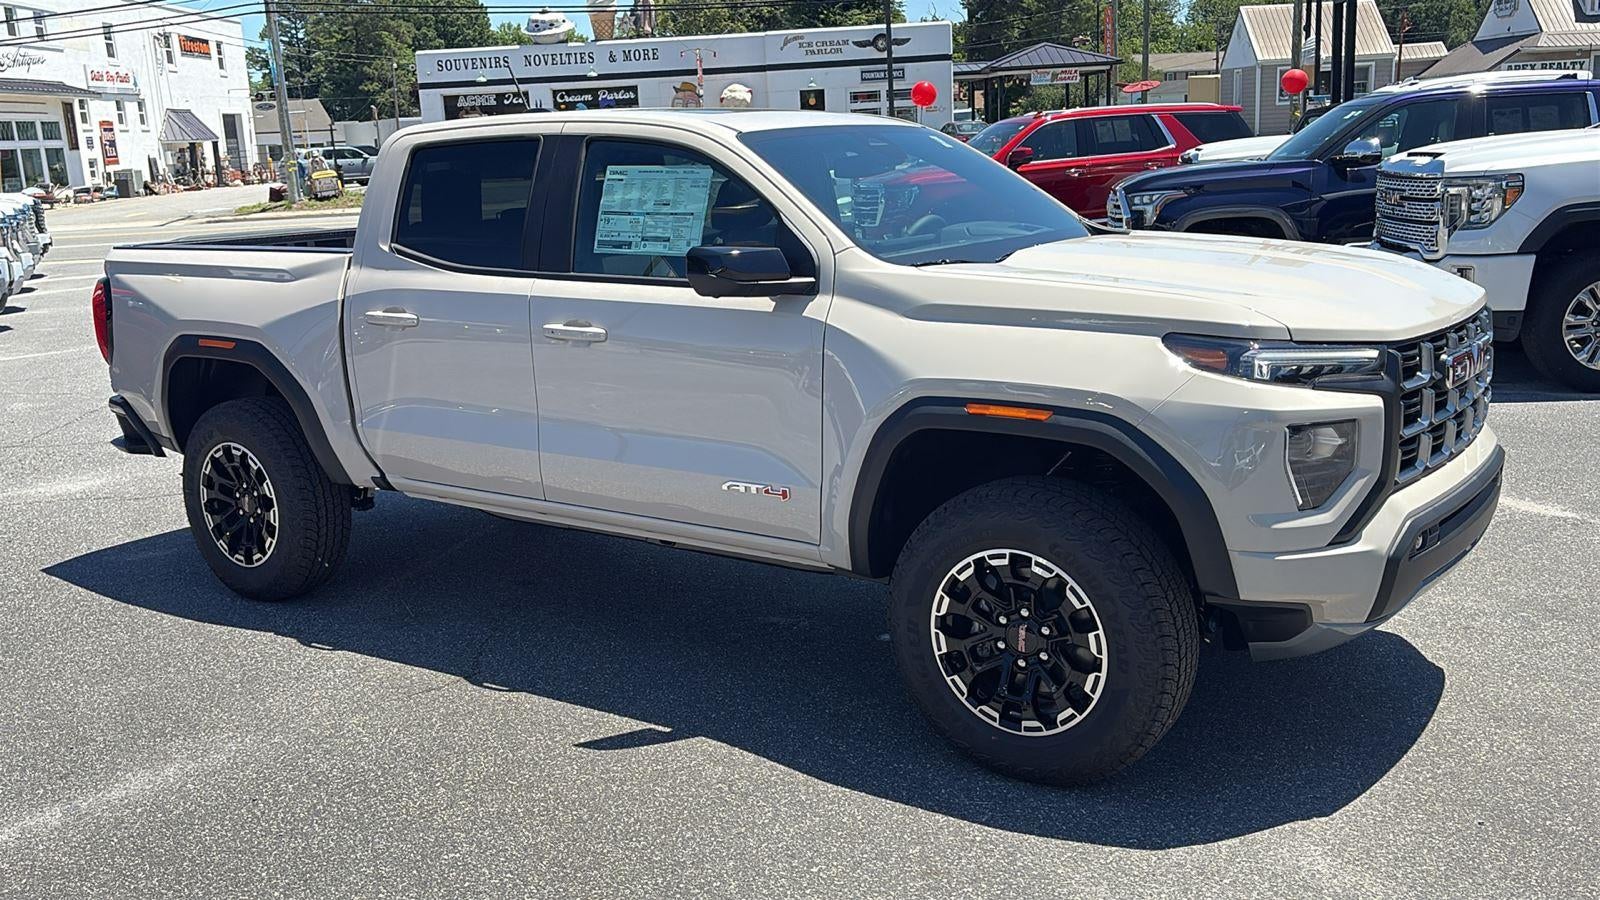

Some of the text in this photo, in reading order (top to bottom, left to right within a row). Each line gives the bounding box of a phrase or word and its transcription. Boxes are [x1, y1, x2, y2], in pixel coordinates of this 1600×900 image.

[815, 39, 850, 47] CREAM
[804, 47, 843, 56] PARLOR
[436, 48, 659, 72] SOUVENIRS NOVELTIES & MORE
[1540, 61, 1585, 70] REALTY
[862, 71, 885, 79] FOUNTAIN
[457, 94, 497, 107] ACME
[556, 92, 593, 103] Cream
[597, 89, 636, 101] Parlor
[721, 480, 791, 502] AT4
